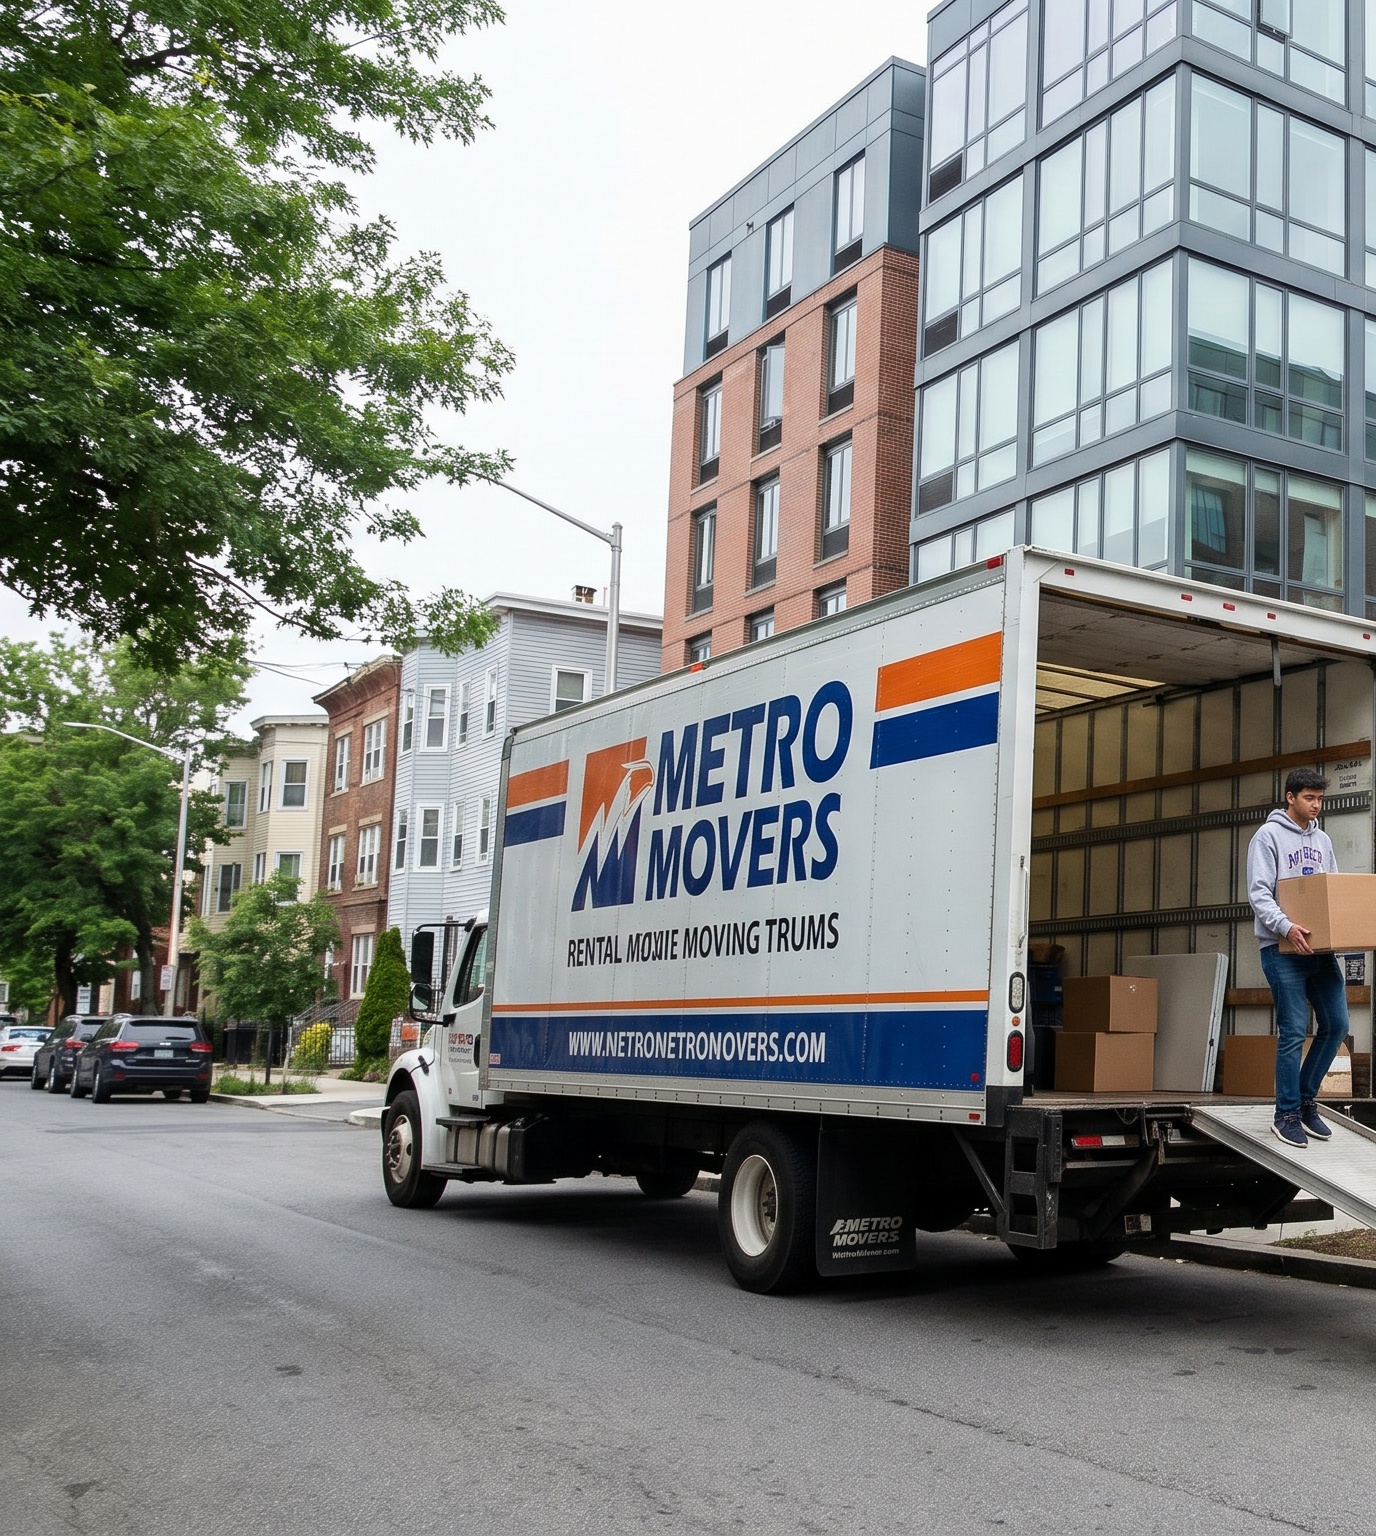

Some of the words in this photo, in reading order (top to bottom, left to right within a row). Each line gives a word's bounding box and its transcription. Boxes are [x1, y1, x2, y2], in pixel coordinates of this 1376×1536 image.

[653, 680, 853, 816] METRO
[645, 792, 841, 902] MOVERS
[567, 934, 622, 967] RENTAL
[682, 919, 761, 959] MOVING
[766, 912, 840, 952] TRUMS
[568, 1031, 826, 1063] WWW.NETRONETRONOVERS.COM
[833, 1231, 899, 1247] MOVERS
[843, 1216, 903, 1232] METRO
